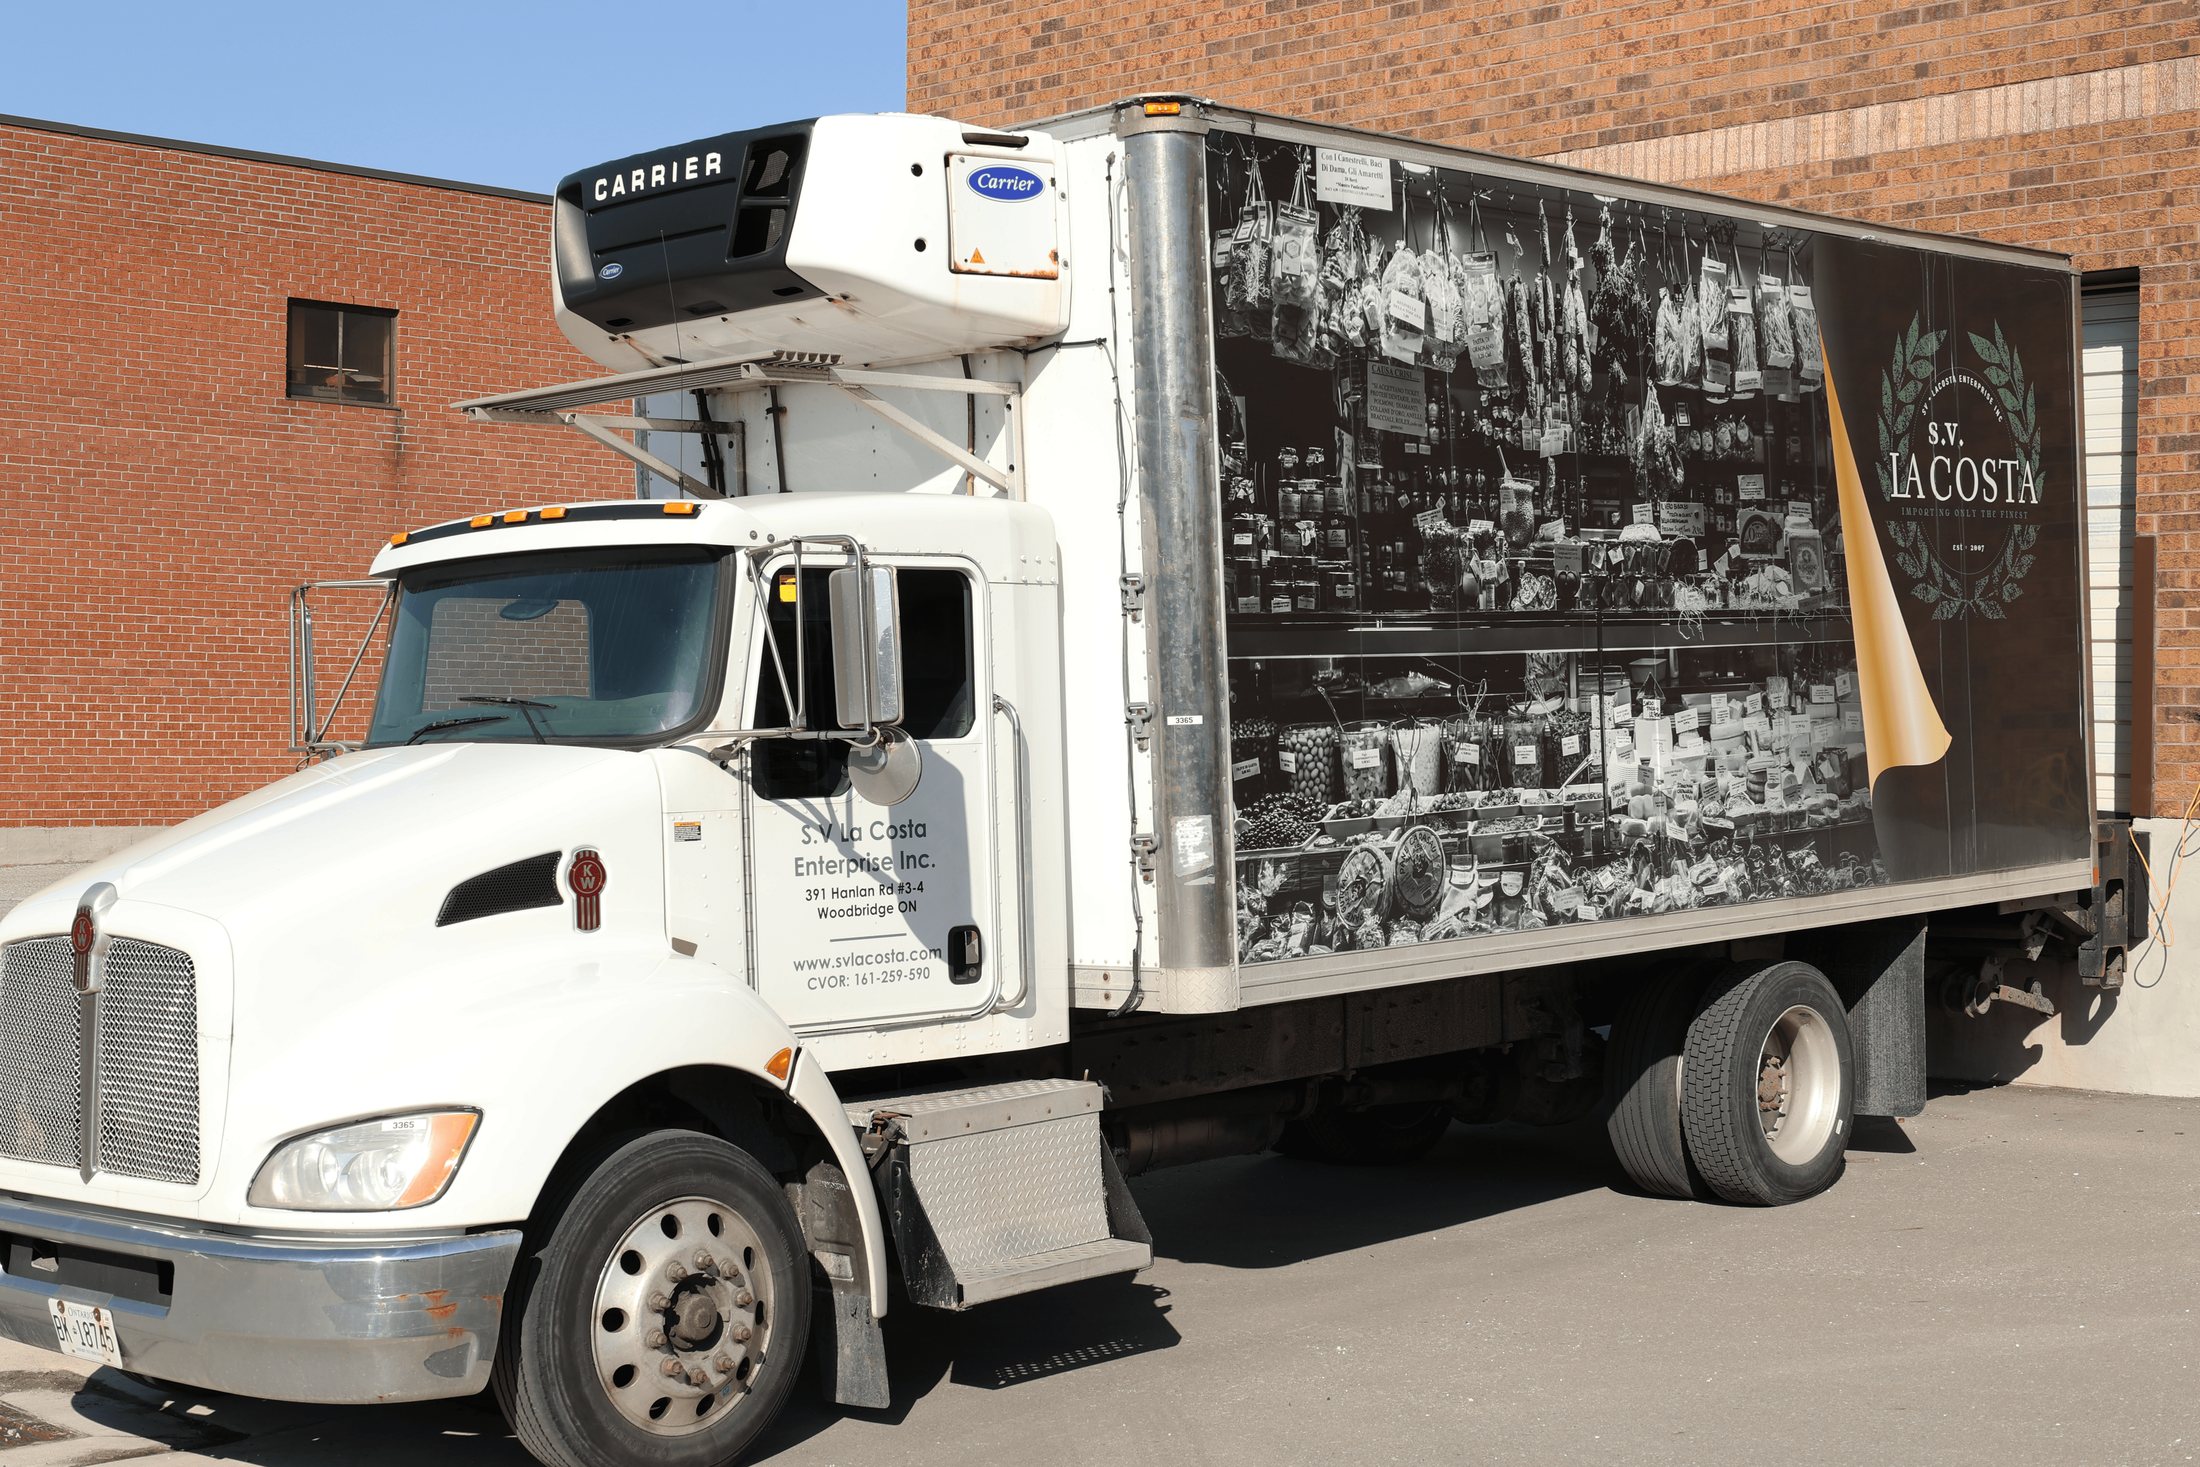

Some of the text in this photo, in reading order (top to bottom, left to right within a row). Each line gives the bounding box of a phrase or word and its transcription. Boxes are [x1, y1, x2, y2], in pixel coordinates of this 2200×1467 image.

[594, 152, 721, 202] CARRIER
[977, 172, 1035, 193] Carrier
[1372, 364, 1393, 376] CAUSA
[1931, 375, 1957, 397] LACOSTA
[1959, 374, 1994, 405] ENTERPRISE
[1928, 422, 1964, 446] S.V.
[1890, 452, 2038, 504] LACOSTA
[1901, 506, 2028, 519] IMPORTING ONLY THE FINEST
[1970, 544, 1985, 552] 2007
[801, 818, 927, 845] S.V La Costa
[794, 850, 936, 878] Enterprise Inc.
[805, 881, 924, 902] 391 Hanlan Rd #3-4
[817, 900, 917, 920] Woodbridge ON
[793, 948, 942, 972] www.svlacosta.com
[807, 967, 930, 990] CVOR: 161-259-590
[393, 1121, 415, 1129] 3365
[53, 1314, 114, 1353] BK 18745
